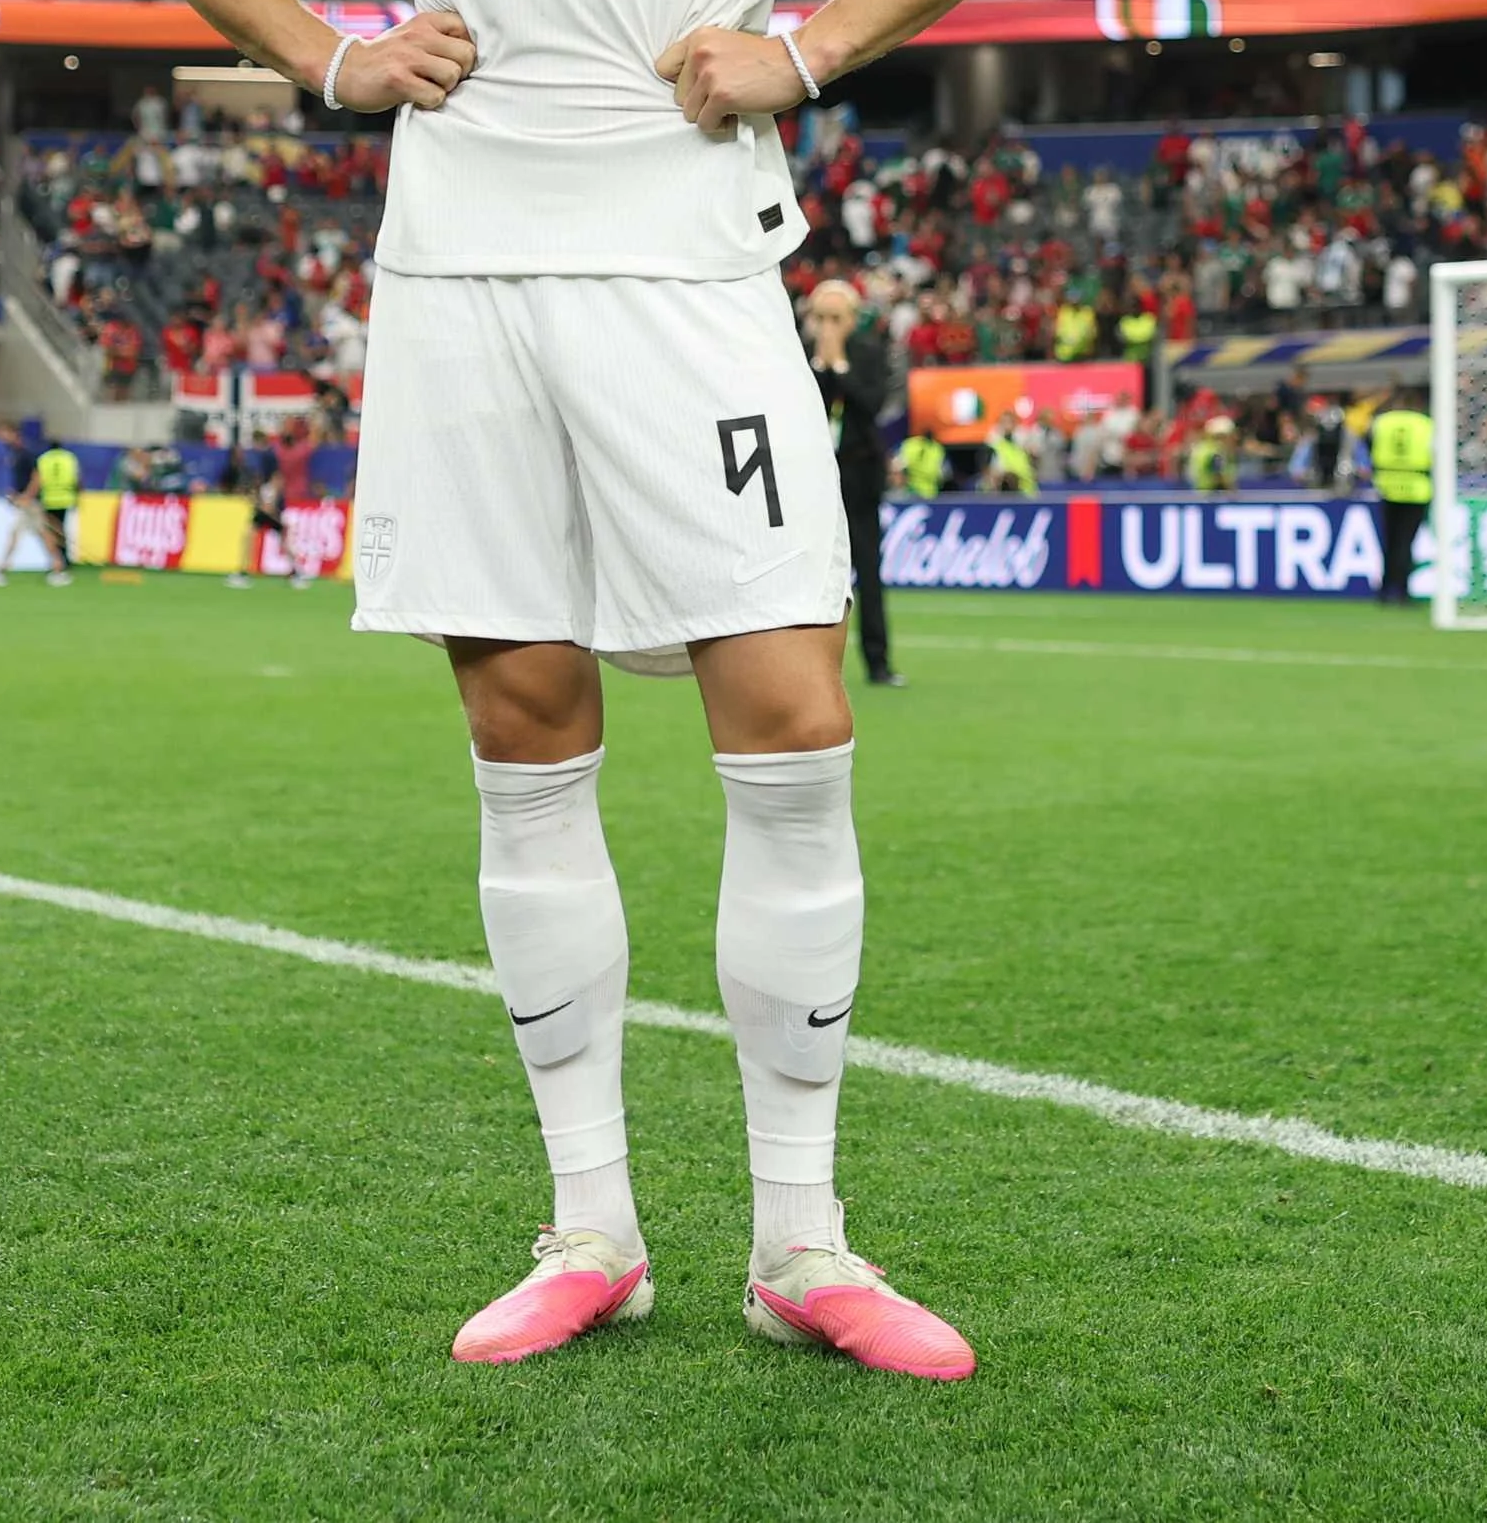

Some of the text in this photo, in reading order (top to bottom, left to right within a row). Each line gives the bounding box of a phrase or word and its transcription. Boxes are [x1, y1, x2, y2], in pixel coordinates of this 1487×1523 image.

[716, 413, 784, 528] 9
[878, 503, 1384, 591] ichelob ULTRA
